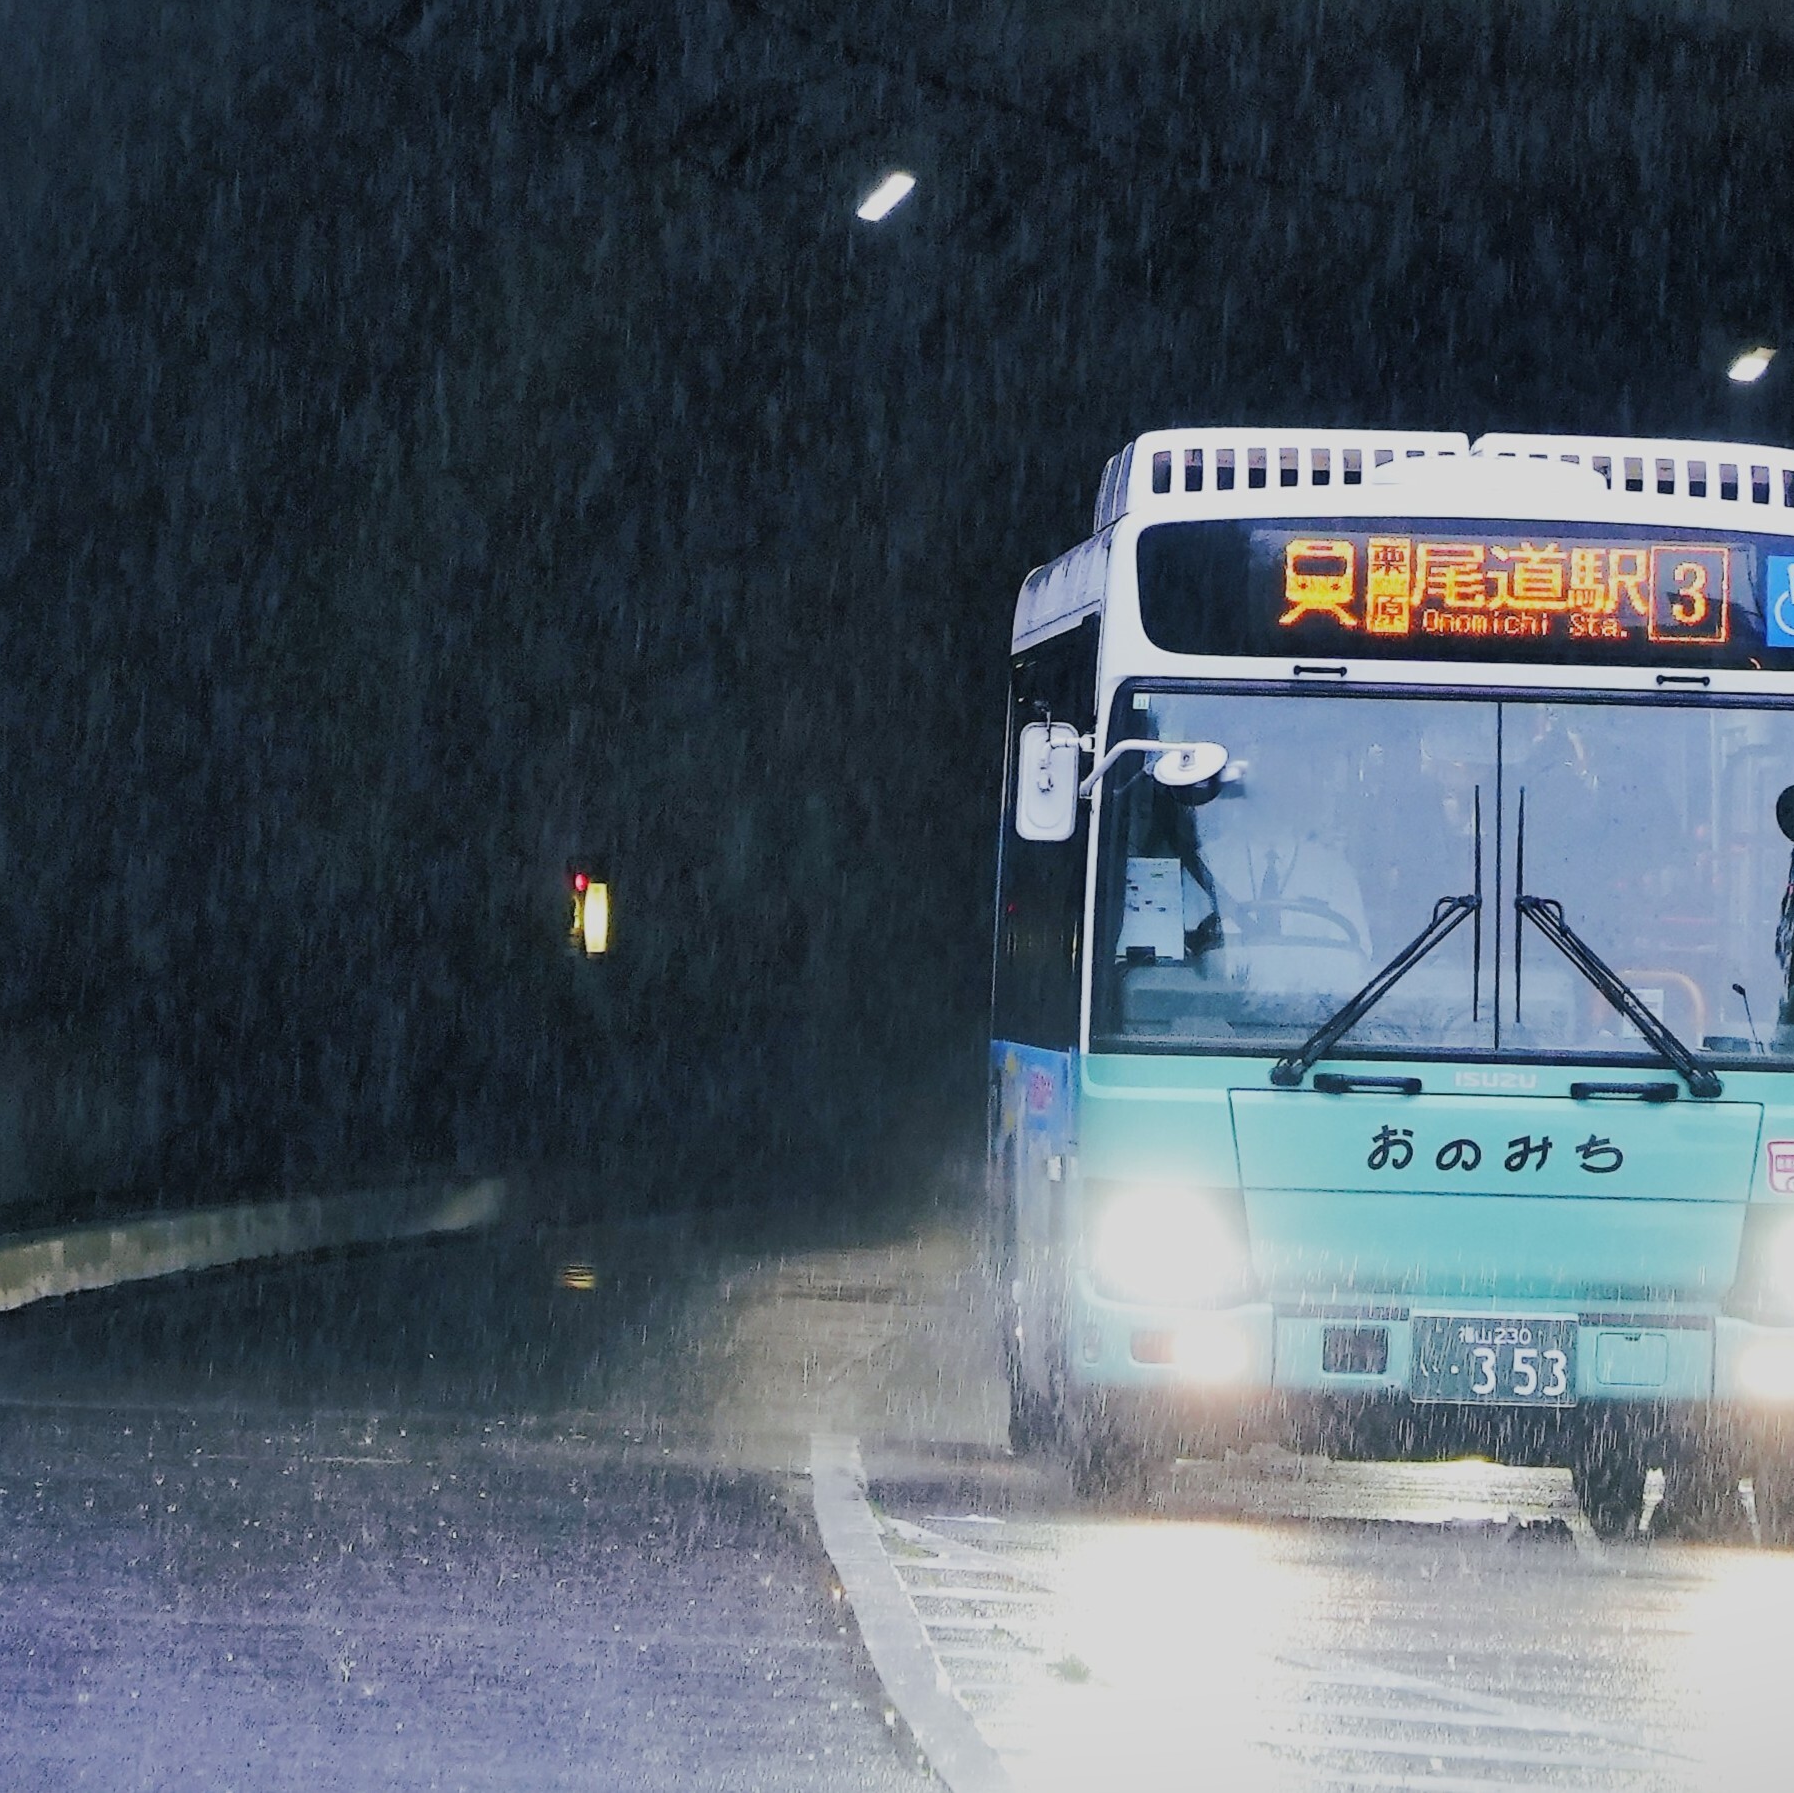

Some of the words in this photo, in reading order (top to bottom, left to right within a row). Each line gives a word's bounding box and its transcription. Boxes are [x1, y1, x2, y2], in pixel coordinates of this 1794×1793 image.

[1370, 542, 1409, 629] 栗原
[1411, 541, 1648, 616] 尾道駅
[1671, 561, 1707, 626] 3
[1423, 608, 1549, 637] Onomichi
[1569, 612, 1628, 638] Sta.
[1455, 1070, 1538, 1089] ISUZU
[1367, 1124, 1624, 1174] おのみち
